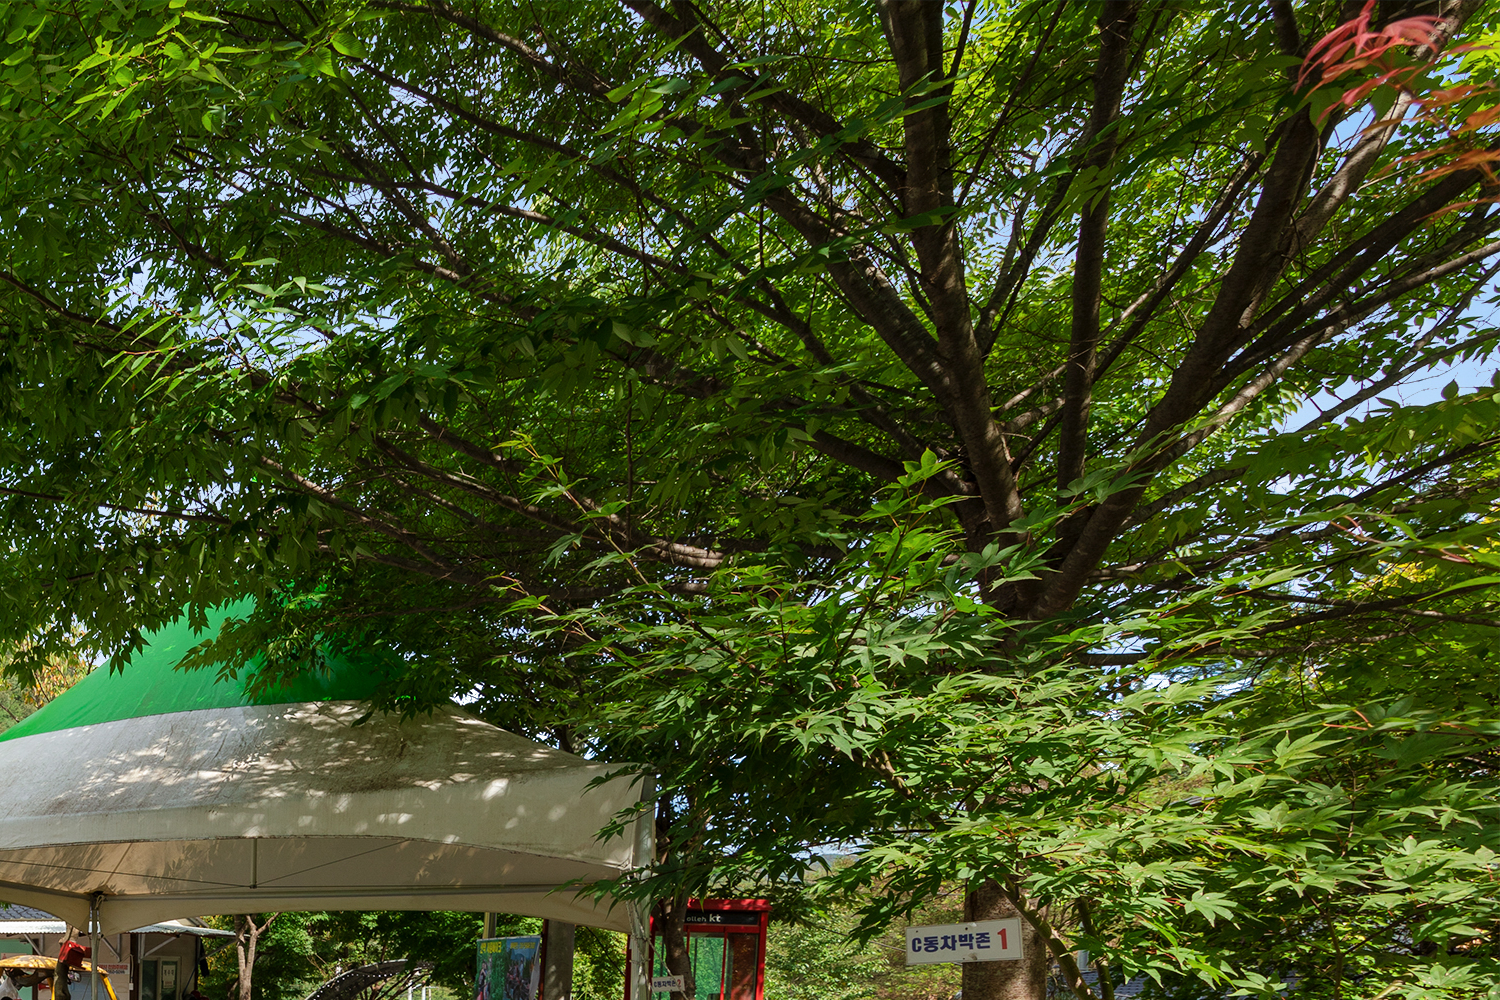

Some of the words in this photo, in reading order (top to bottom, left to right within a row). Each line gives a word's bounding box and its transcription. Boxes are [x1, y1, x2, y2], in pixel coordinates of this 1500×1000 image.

[709, 914, 721, 922] kt
[911, 931, 991, 953] C동차박존
[997, 927, 1008, 950] 1
